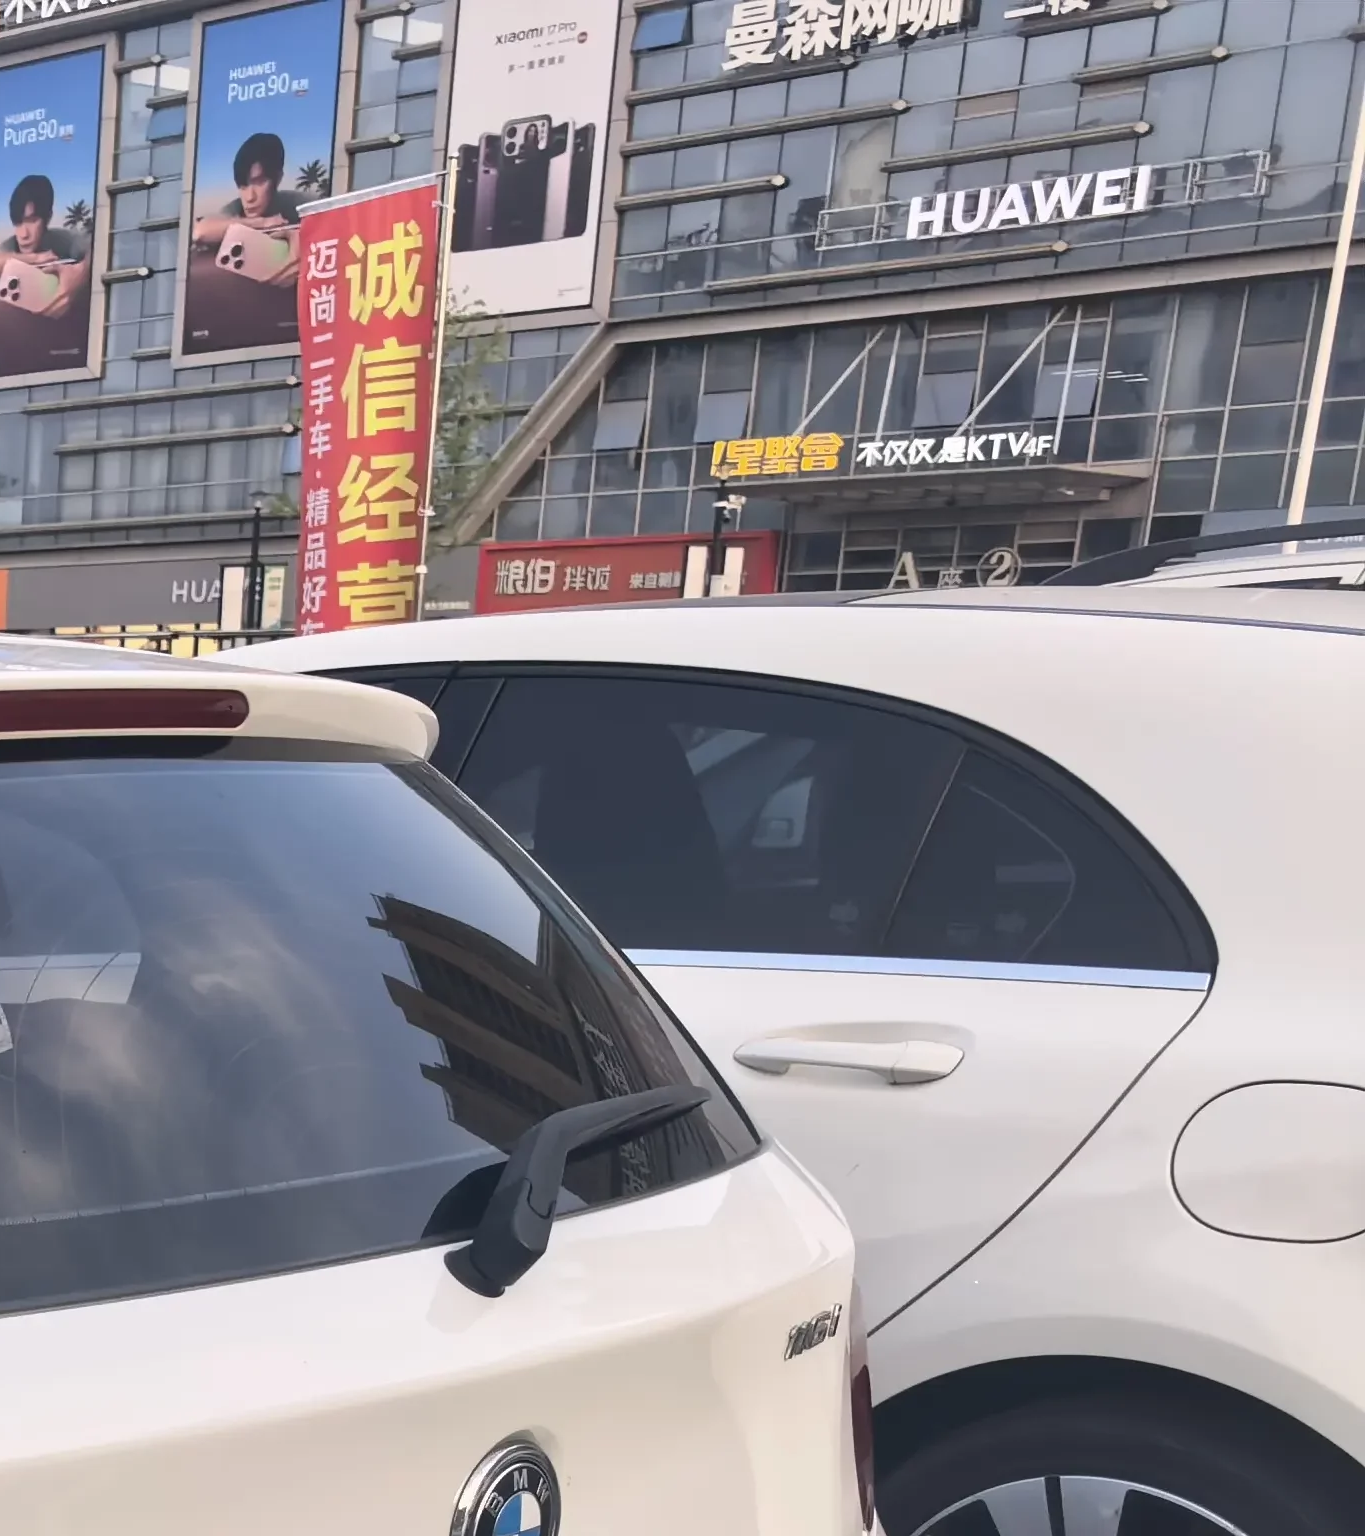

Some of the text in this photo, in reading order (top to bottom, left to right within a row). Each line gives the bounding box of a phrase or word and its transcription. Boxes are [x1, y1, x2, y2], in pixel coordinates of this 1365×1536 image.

[229, 61, 276, 80] HUAWEI
[4, 108, 47, 126] HUAWEI
[907, 164, 1151, 240] HUAWEI
[337, 219, 424, 631] 诚信经营
[485, 1468, 551, 1517] BMW
